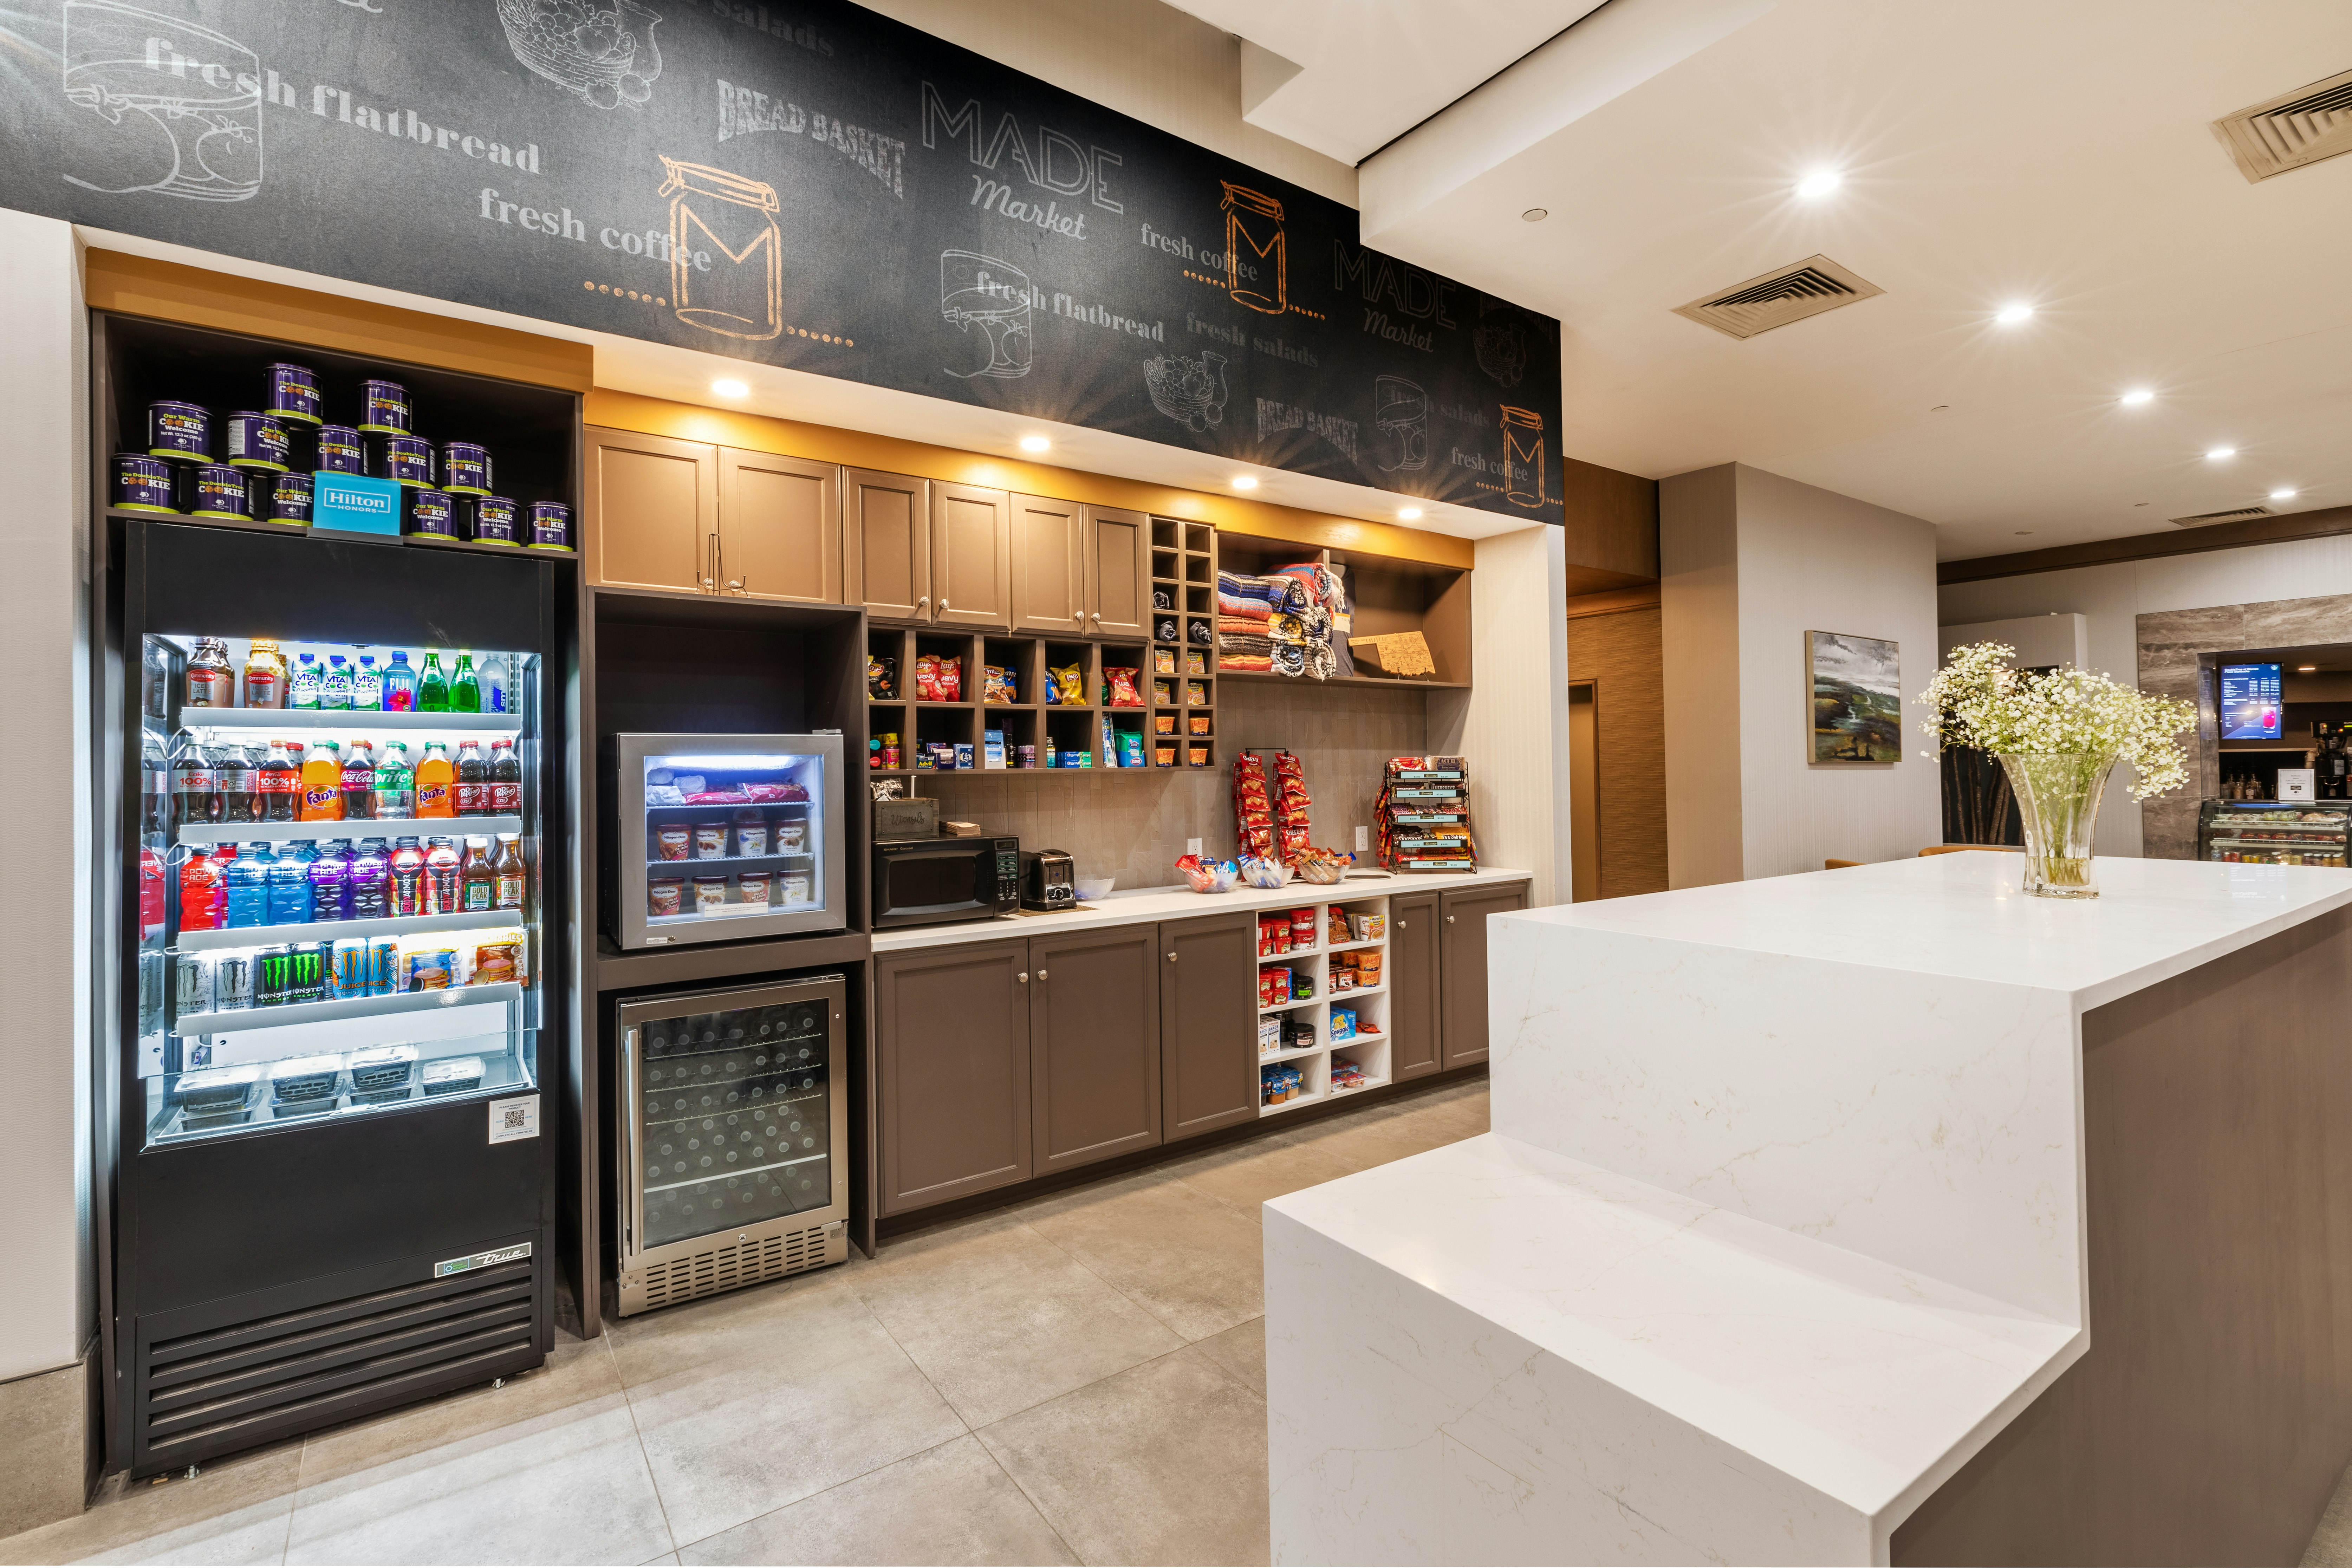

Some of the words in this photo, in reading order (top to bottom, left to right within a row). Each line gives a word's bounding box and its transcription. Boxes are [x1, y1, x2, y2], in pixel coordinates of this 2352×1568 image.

[145, 37, 297, 108] fresh
[311, 84, 542, 176] flatbread
[717, 78, 805, 143] BREAD
[812, 111, 905, 200] BASKET
[922, 80, 1123, 215] MADE
[970, 174, 1087, 240] Market
[479, 188, 587, 242] fresh
[600, 226, 712, 272] coffee
[1141, 223, 1195, 261] fresh
[1201, 247, 1258, 281] coffee
[1334, 238, 1456, 331] MADE
[977, 271, 1047, 310] fresh
[1053, 292, 1164, 343] flatbread
[1363, 307, 1434, 353] Market
[1187, 311, 1247, 347] fresh
[1253, 337, 1319, 368] salads
[279, 385, 320, 401] COOKIE
[291, 382, 319, 394] DoubleTree
[370, 401, 408, 416] COOKIE
[380, 397, 408, 408] DoubleTree
[159, 418, 204, 431] COOKIE
[178, 415, 200, 424] Warm
[165, 425, 198, 435] Welcome
[1256, 397, 1304, 444] BREAD
[1307, 410, 1358, 465] BASKET
[319, 446, 360, 458] COOKIE
[329, 442, 360, 451] DoubleTree
[387, 455, 426, 466] COOKIE
[1451, 447, 1486, 472] fresh
[1490, 460, 1528, 481] coffee
[446, 463, 482, 473] COOKIE
[121, 477, 170, 490] COOKIE
[133, 473, 170, 482] DoubleTree
[199, 485, 244, 498] COOKIE
[209, 481, 244, 490] DoubleTree
[330, 492, 384, 508] Hilton
[338, 505, 377, 513] HONORS
[917, 660, 932, 669] Lay's
[940, 662, 956, 670] Lay's
[1067, 673, 1078, 681] Lay's
[389, 677, 410, 691] FIJI
[918, 761, 933, 769] Advil
[180, 778, 212, 786] 100%
[340, 771, 375, 783] Coca-Cola
[306, 788, 337, 806] Fanta
[461, 789, 479, 798] Pepper
[496, 789, 514, 798] Pepper
[891, 812, 925, 826] Utensils
[403, 874, 411, 913] BODYARMOR
[442, 872, 450, 911] BODYARMOR
[338, 981, 366, 990] JUICE
[217, 995, 253, 1003] MONSTER
[1330, 1025, 1349, 1037] Snuggle
